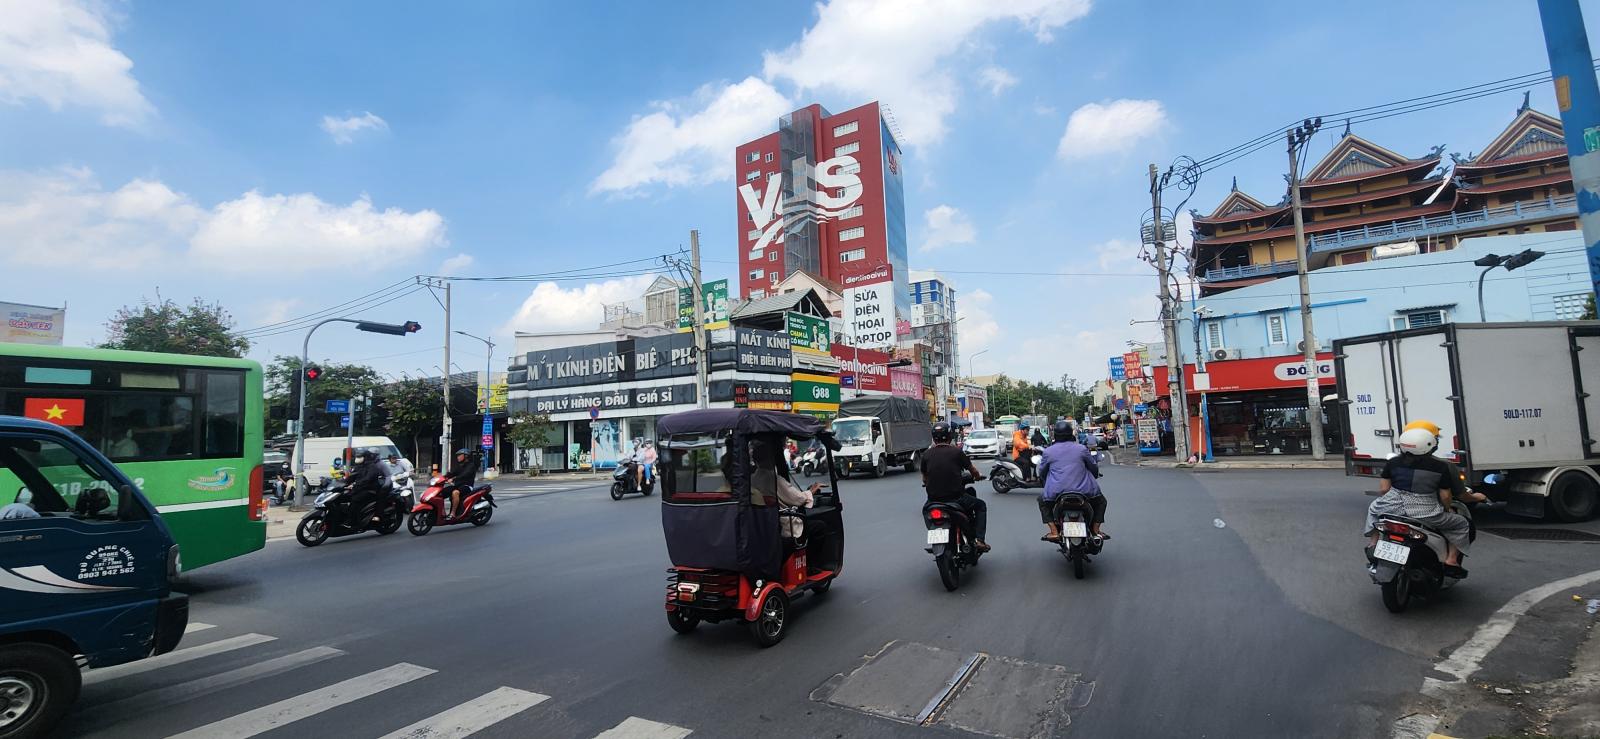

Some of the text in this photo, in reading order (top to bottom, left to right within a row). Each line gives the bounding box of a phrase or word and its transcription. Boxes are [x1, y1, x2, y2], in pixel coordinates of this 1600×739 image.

[854, 289, 878, 302] SỬA
[855, 303, 880, 317] ĐIỆN
[851, 317, 884, 331] THOẠI
[740, 329, 790, 350] MẮT KÍNH
[848, 331, 892, 345] LAPTOP
[556, 355, 590, 378] KÍNH
[592, 351, 625, 378] ĐIỆN
[741, 351, 790, 368] ĐIỆN BIÊN PHỦ
[770, 387, 784, 395] GIÁ
[537, 388, 673, 413] ĐẠI LÝ HÀNG ĐẦU GIÁ SỈ
[1357, 395, 1371, 403] 50LD
[1356, 406, 1376, 415] 117.07
[1503, 408, 1542, 420] 50LD-117.07
[78, 571, 100, 580] 0903
